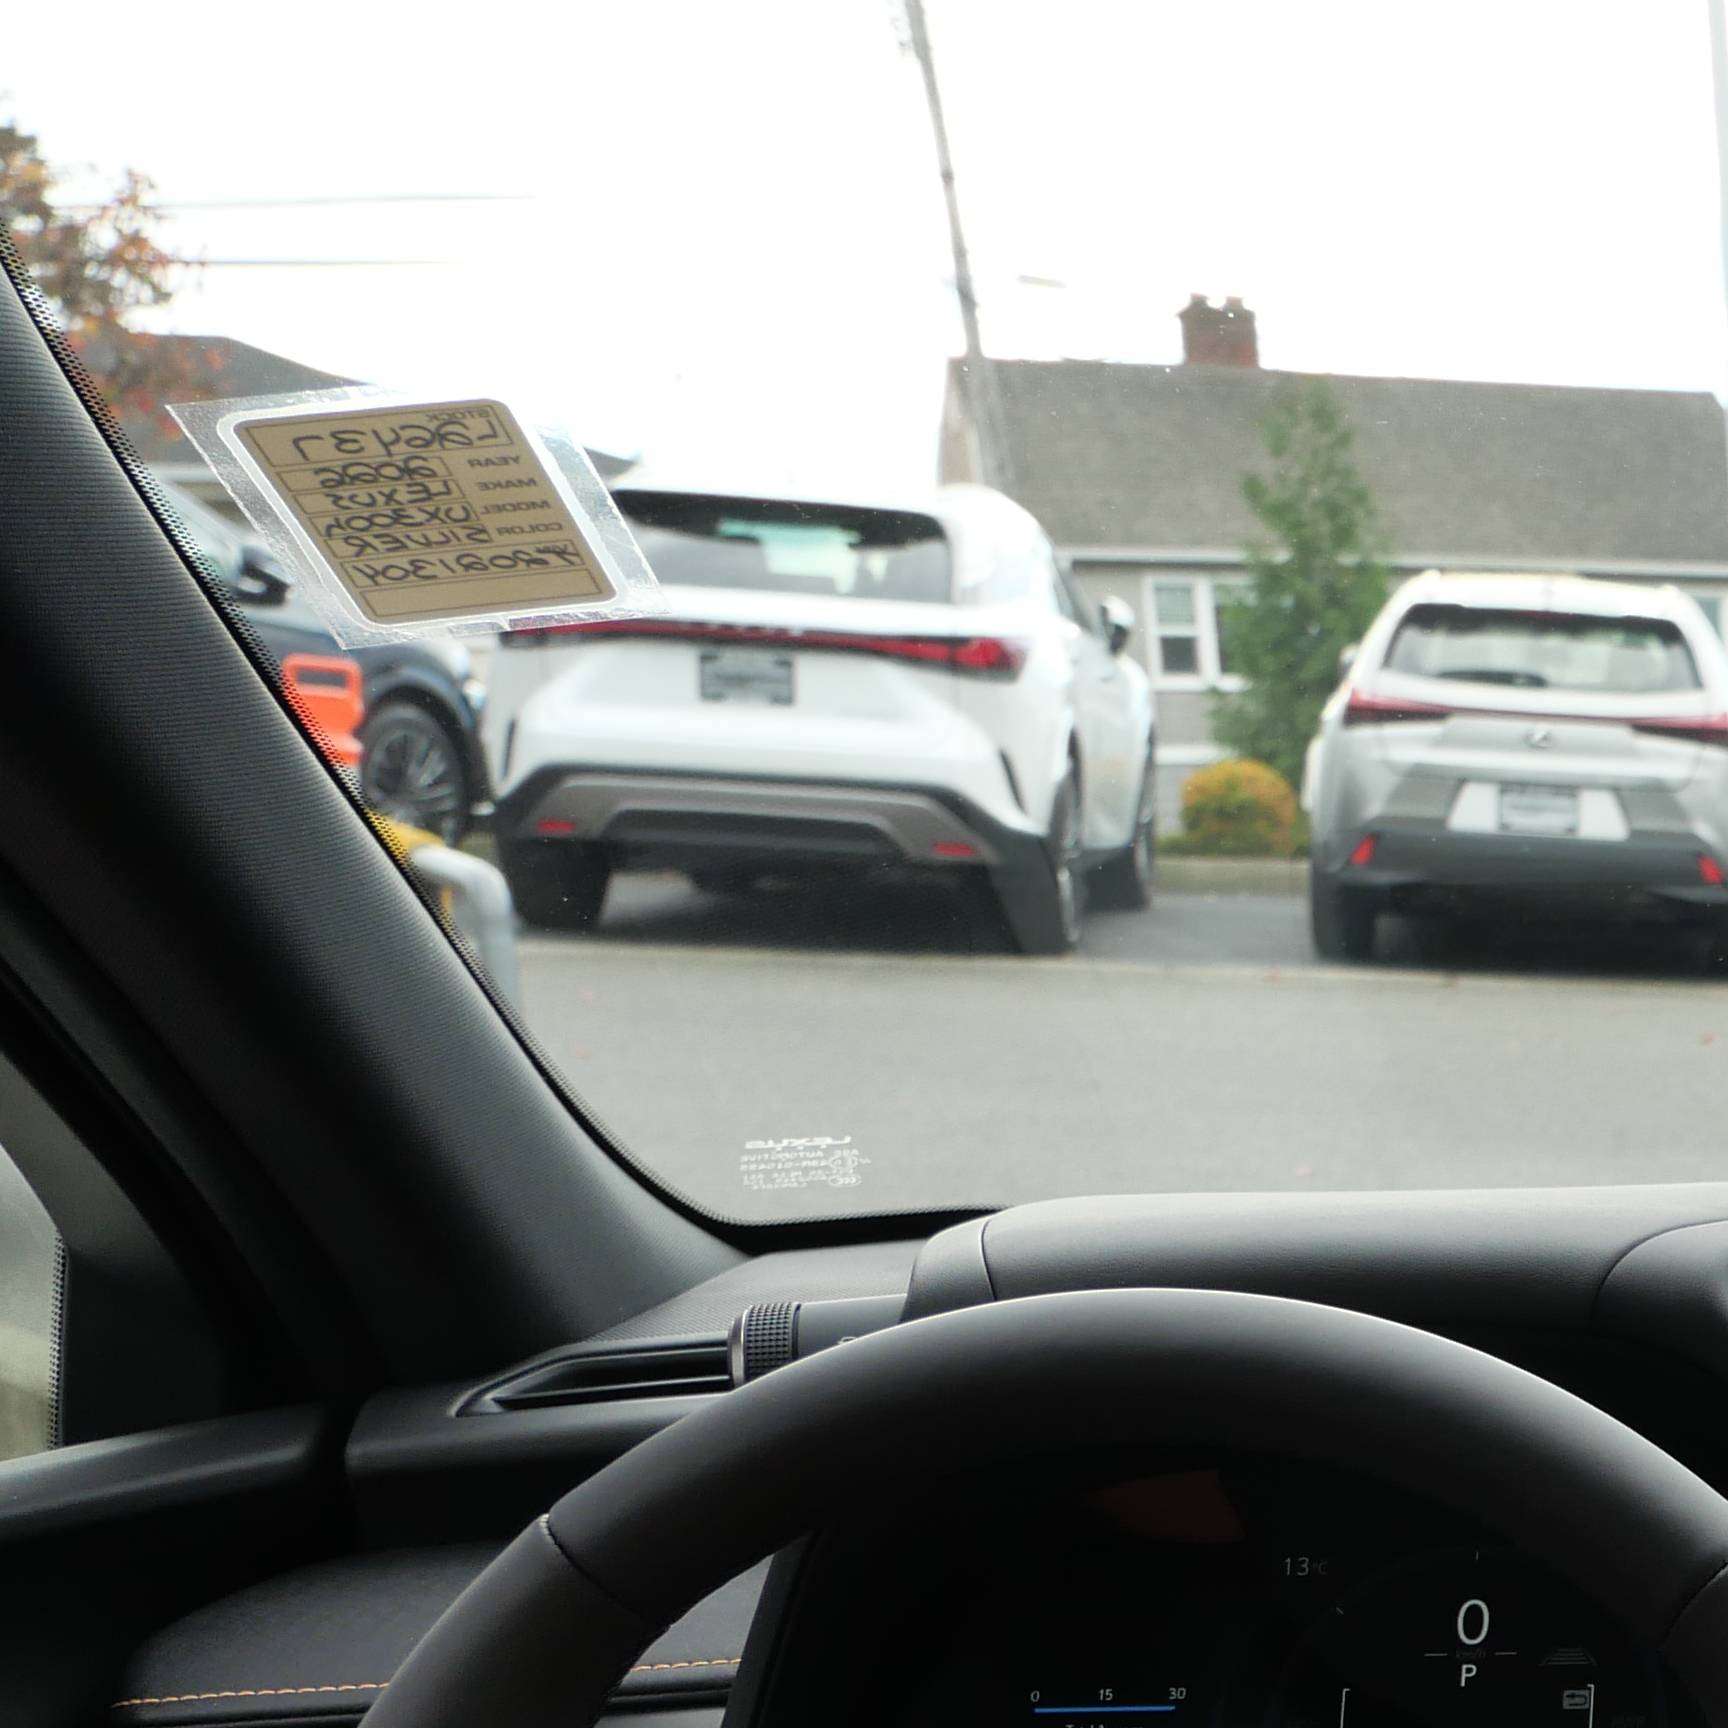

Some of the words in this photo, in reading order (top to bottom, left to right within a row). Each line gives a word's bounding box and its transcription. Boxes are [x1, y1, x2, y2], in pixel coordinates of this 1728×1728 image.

[1456, 1598, 1490, 1646] 0
[1460, 1664, 1478, 1688] P
[1030, 1690, 1040, 1703] 0
[1098, 1688, 1113, 1701] 15
[1168, 1687, 1186, 1700] 30
